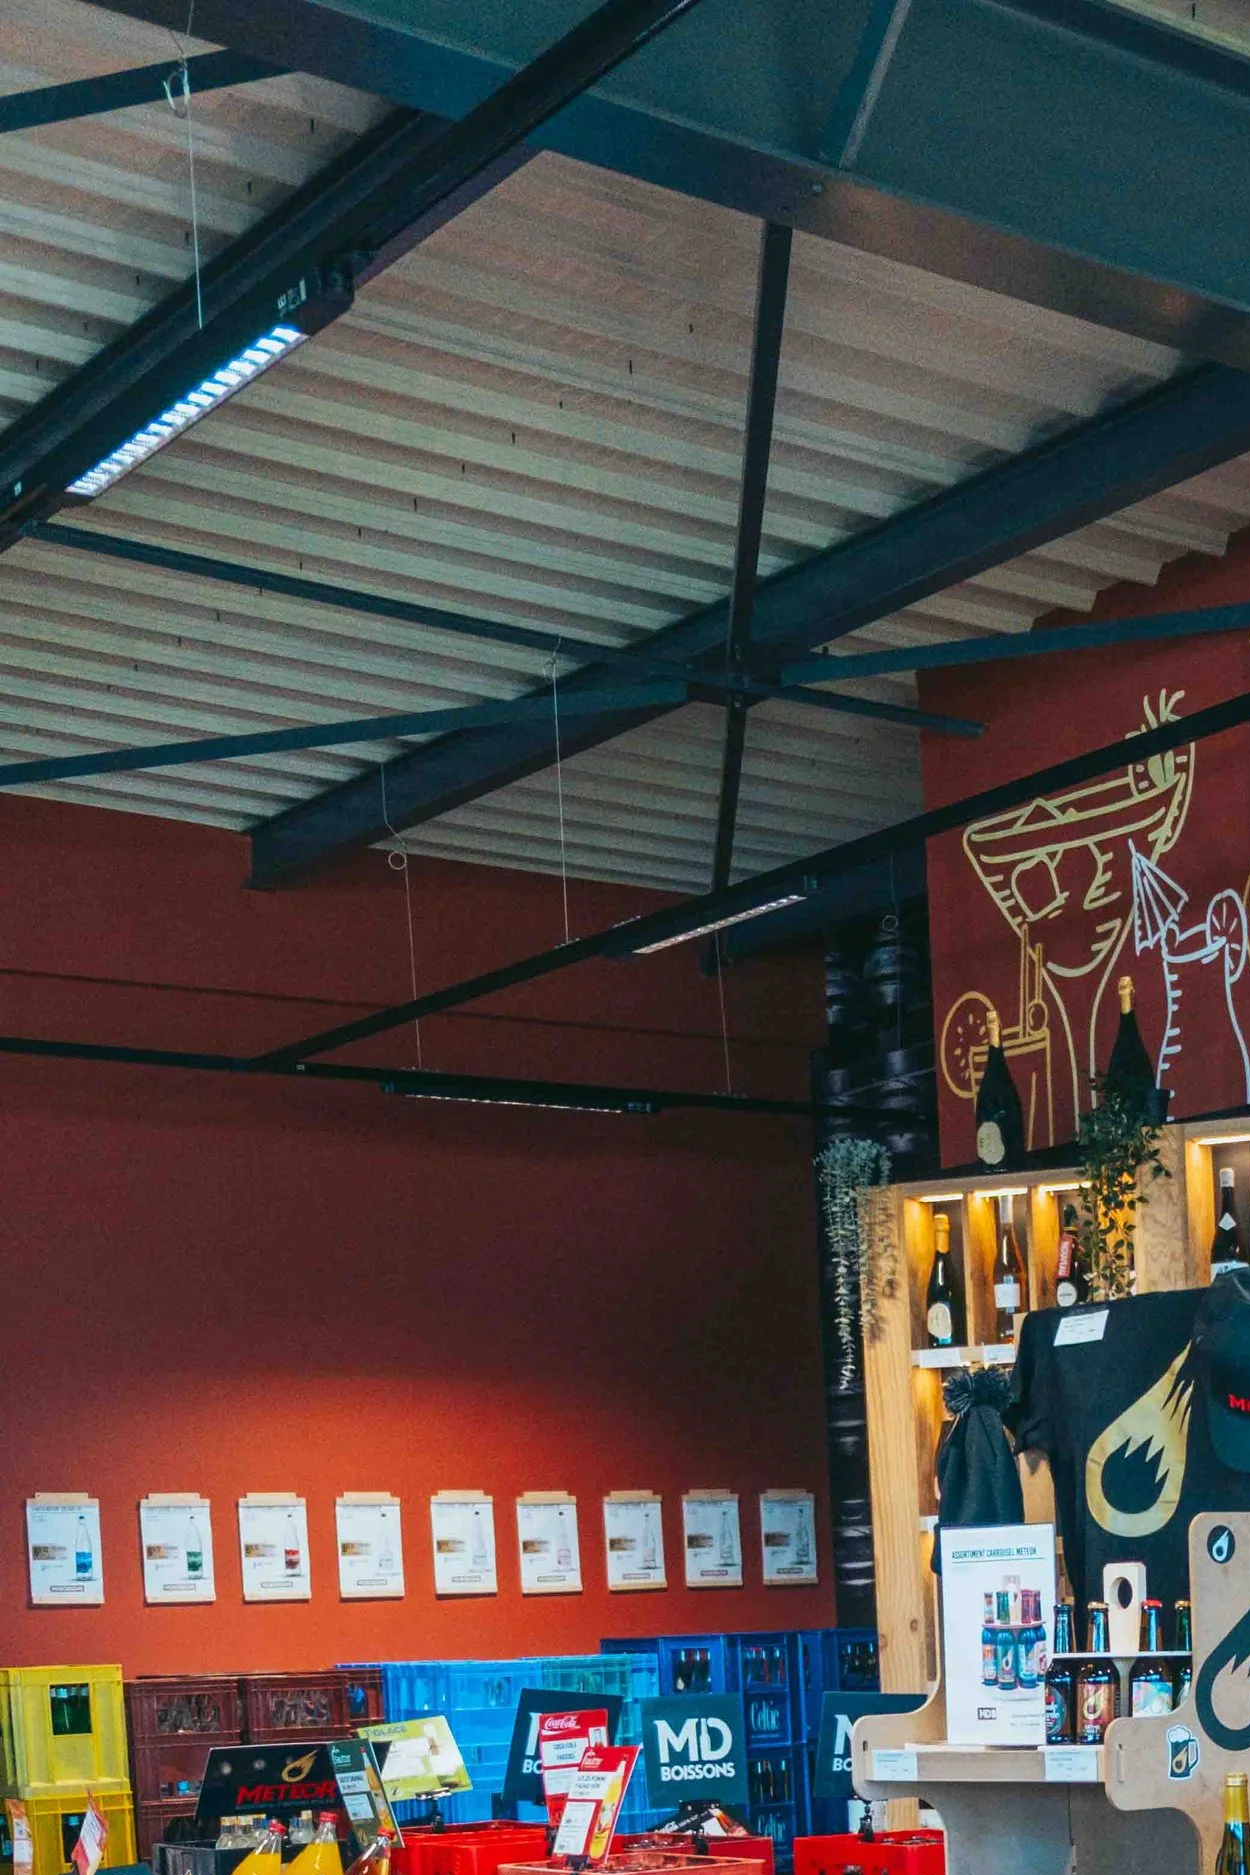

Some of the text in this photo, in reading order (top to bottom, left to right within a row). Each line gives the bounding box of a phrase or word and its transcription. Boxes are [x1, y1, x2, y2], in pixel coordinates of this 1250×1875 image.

[653, 1716, 734, 1765] MD
[660, 1761, 736, 1783] BOISSONS
[236, 1780, 337, 1805] METEOR
